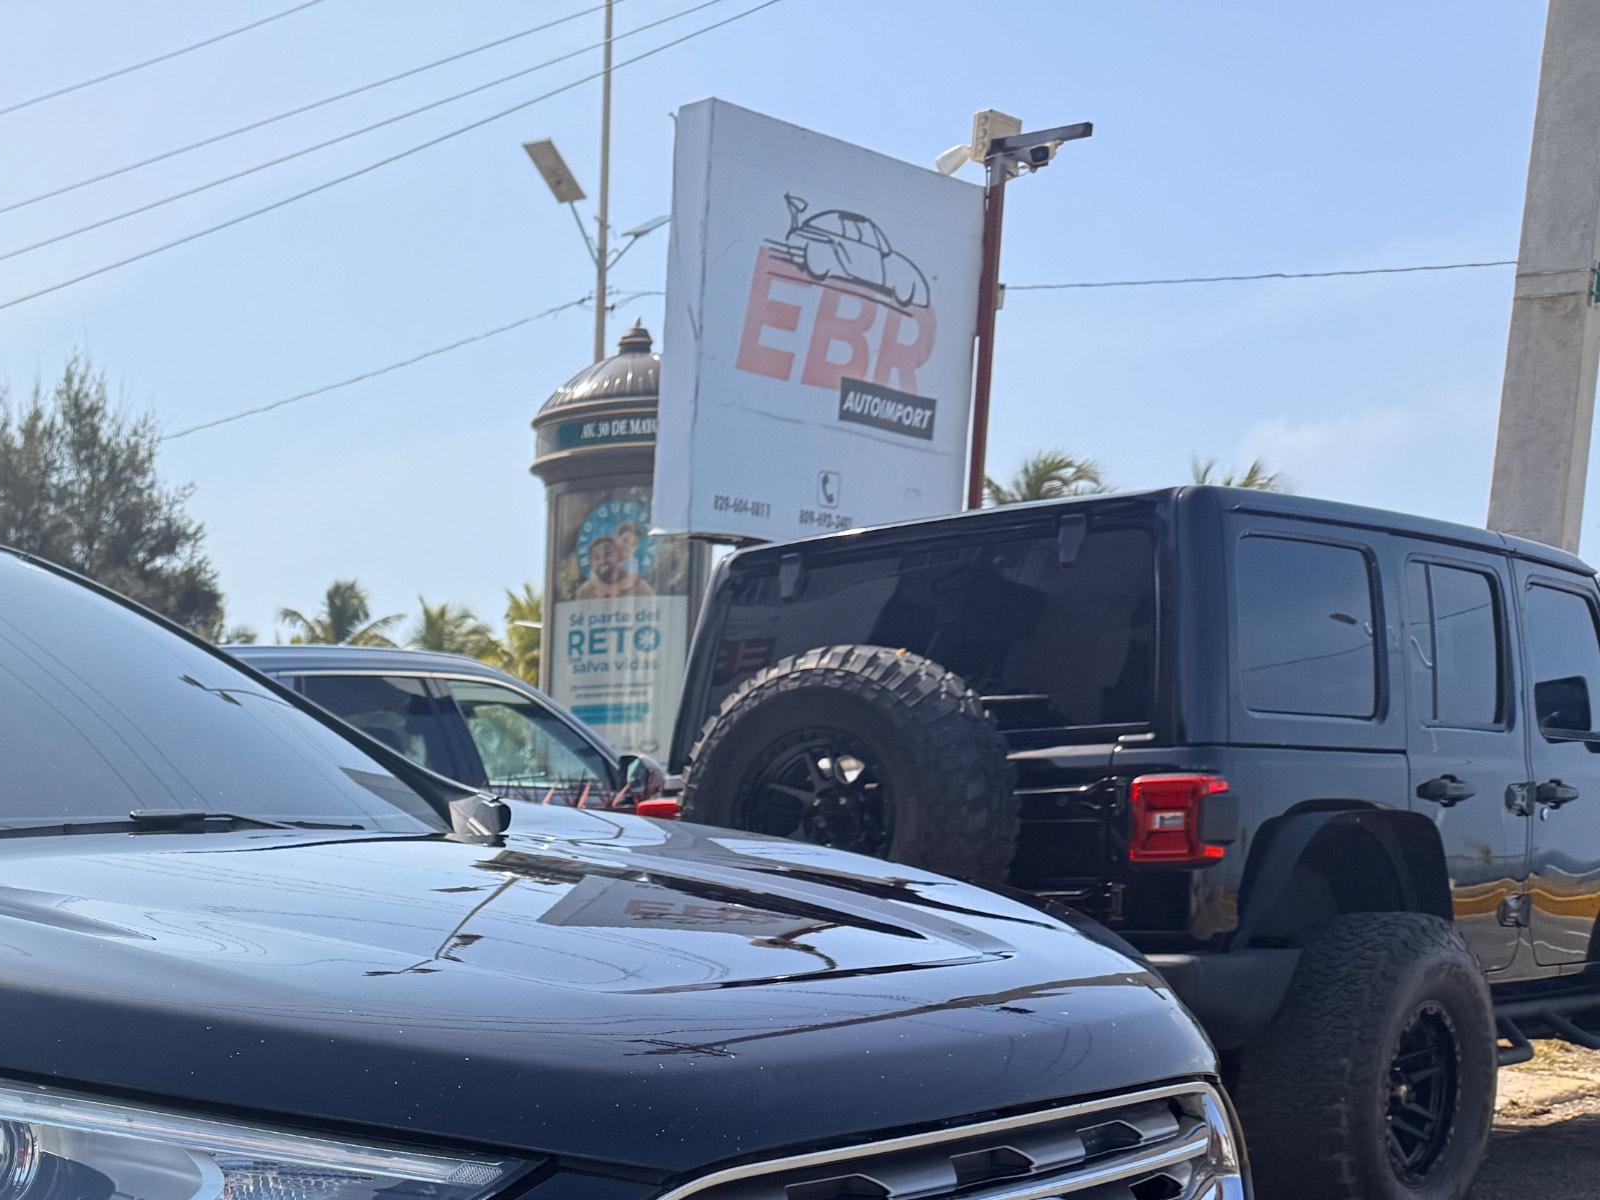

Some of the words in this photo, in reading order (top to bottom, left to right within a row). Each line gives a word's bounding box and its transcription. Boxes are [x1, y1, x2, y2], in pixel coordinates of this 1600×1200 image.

[736, 246, 938, 395] EBR
[842, 391, 933, 430] AUTOIMPORT
[611, 419, 628, 436] DE
[588, 611, 632, 627] parte
[635, 607, 661, 622] del
[567, 626, 661, 656] RETO
